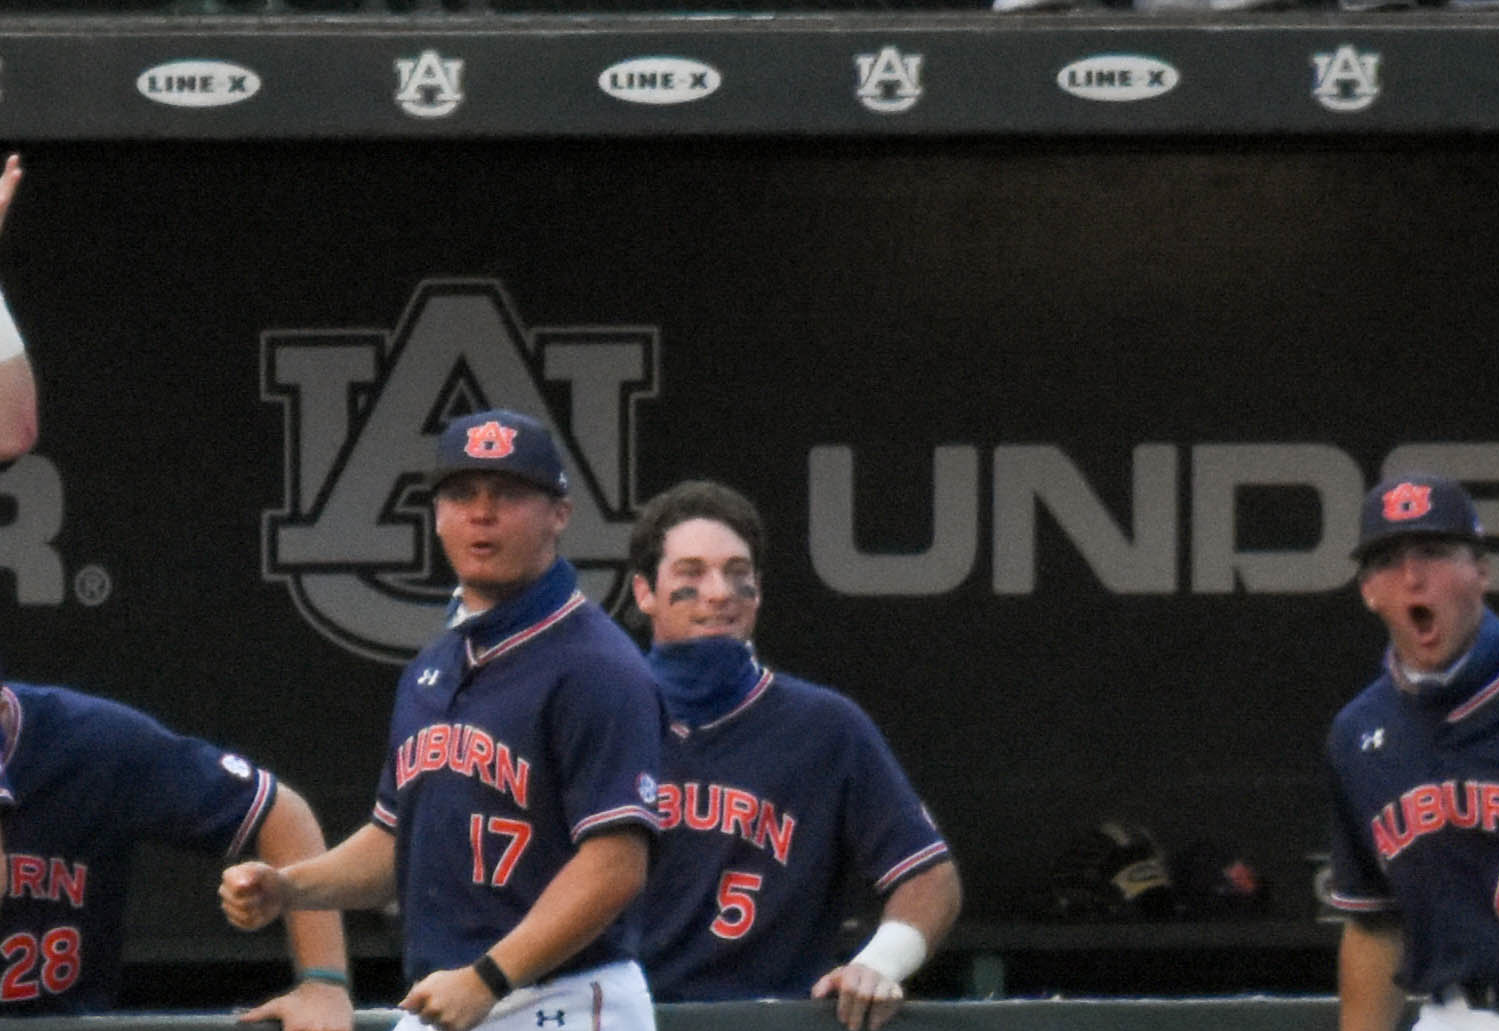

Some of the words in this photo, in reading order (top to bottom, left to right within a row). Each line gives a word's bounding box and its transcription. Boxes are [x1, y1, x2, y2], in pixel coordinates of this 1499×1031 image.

[470, 813, 532, 887] 17
[709, 870, 763, 940] 5
[0, 926, 81, 1003] 28
